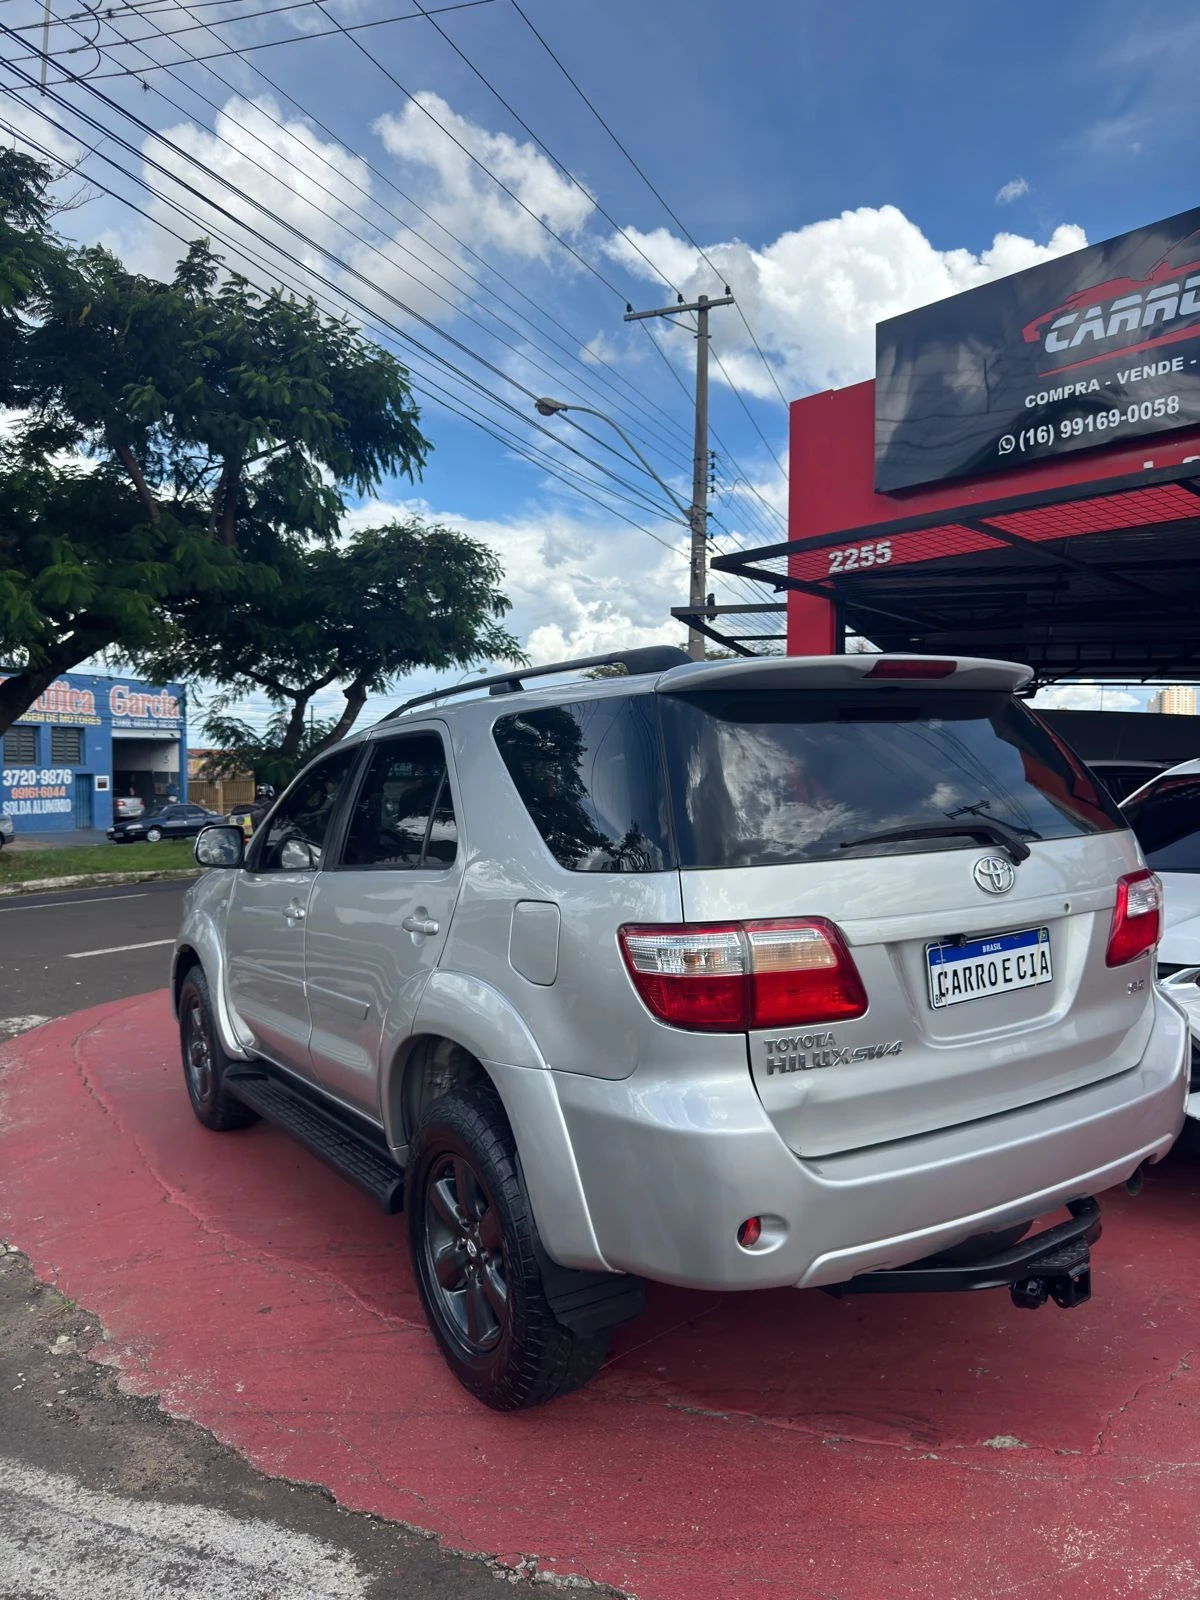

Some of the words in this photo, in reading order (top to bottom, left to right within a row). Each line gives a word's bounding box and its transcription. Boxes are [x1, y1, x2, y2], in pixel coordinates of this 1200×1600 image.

[1025, 378, 1100, 408] COMPRA
[1117, 356, 1184, 385] VENDE
[1019, 425, 1054, 451] (16)
[1060, 395, 1180, 439] 99169-0058
[828, 541, 892, 574] 2255
[109, 684, 180, 719] Garcia
[46, 713, 58, 723] DE
[60, 713, 102, 726] MOTORES
[2, 800, 32, 815] SOLDA
[982, 943, 1003, 953] BRASIL
[764, 1031, 836, 1054] TOYOTA
[766, 1047, 850, 1076] HILUX
[850, 1040, 903, 1064] SW4
